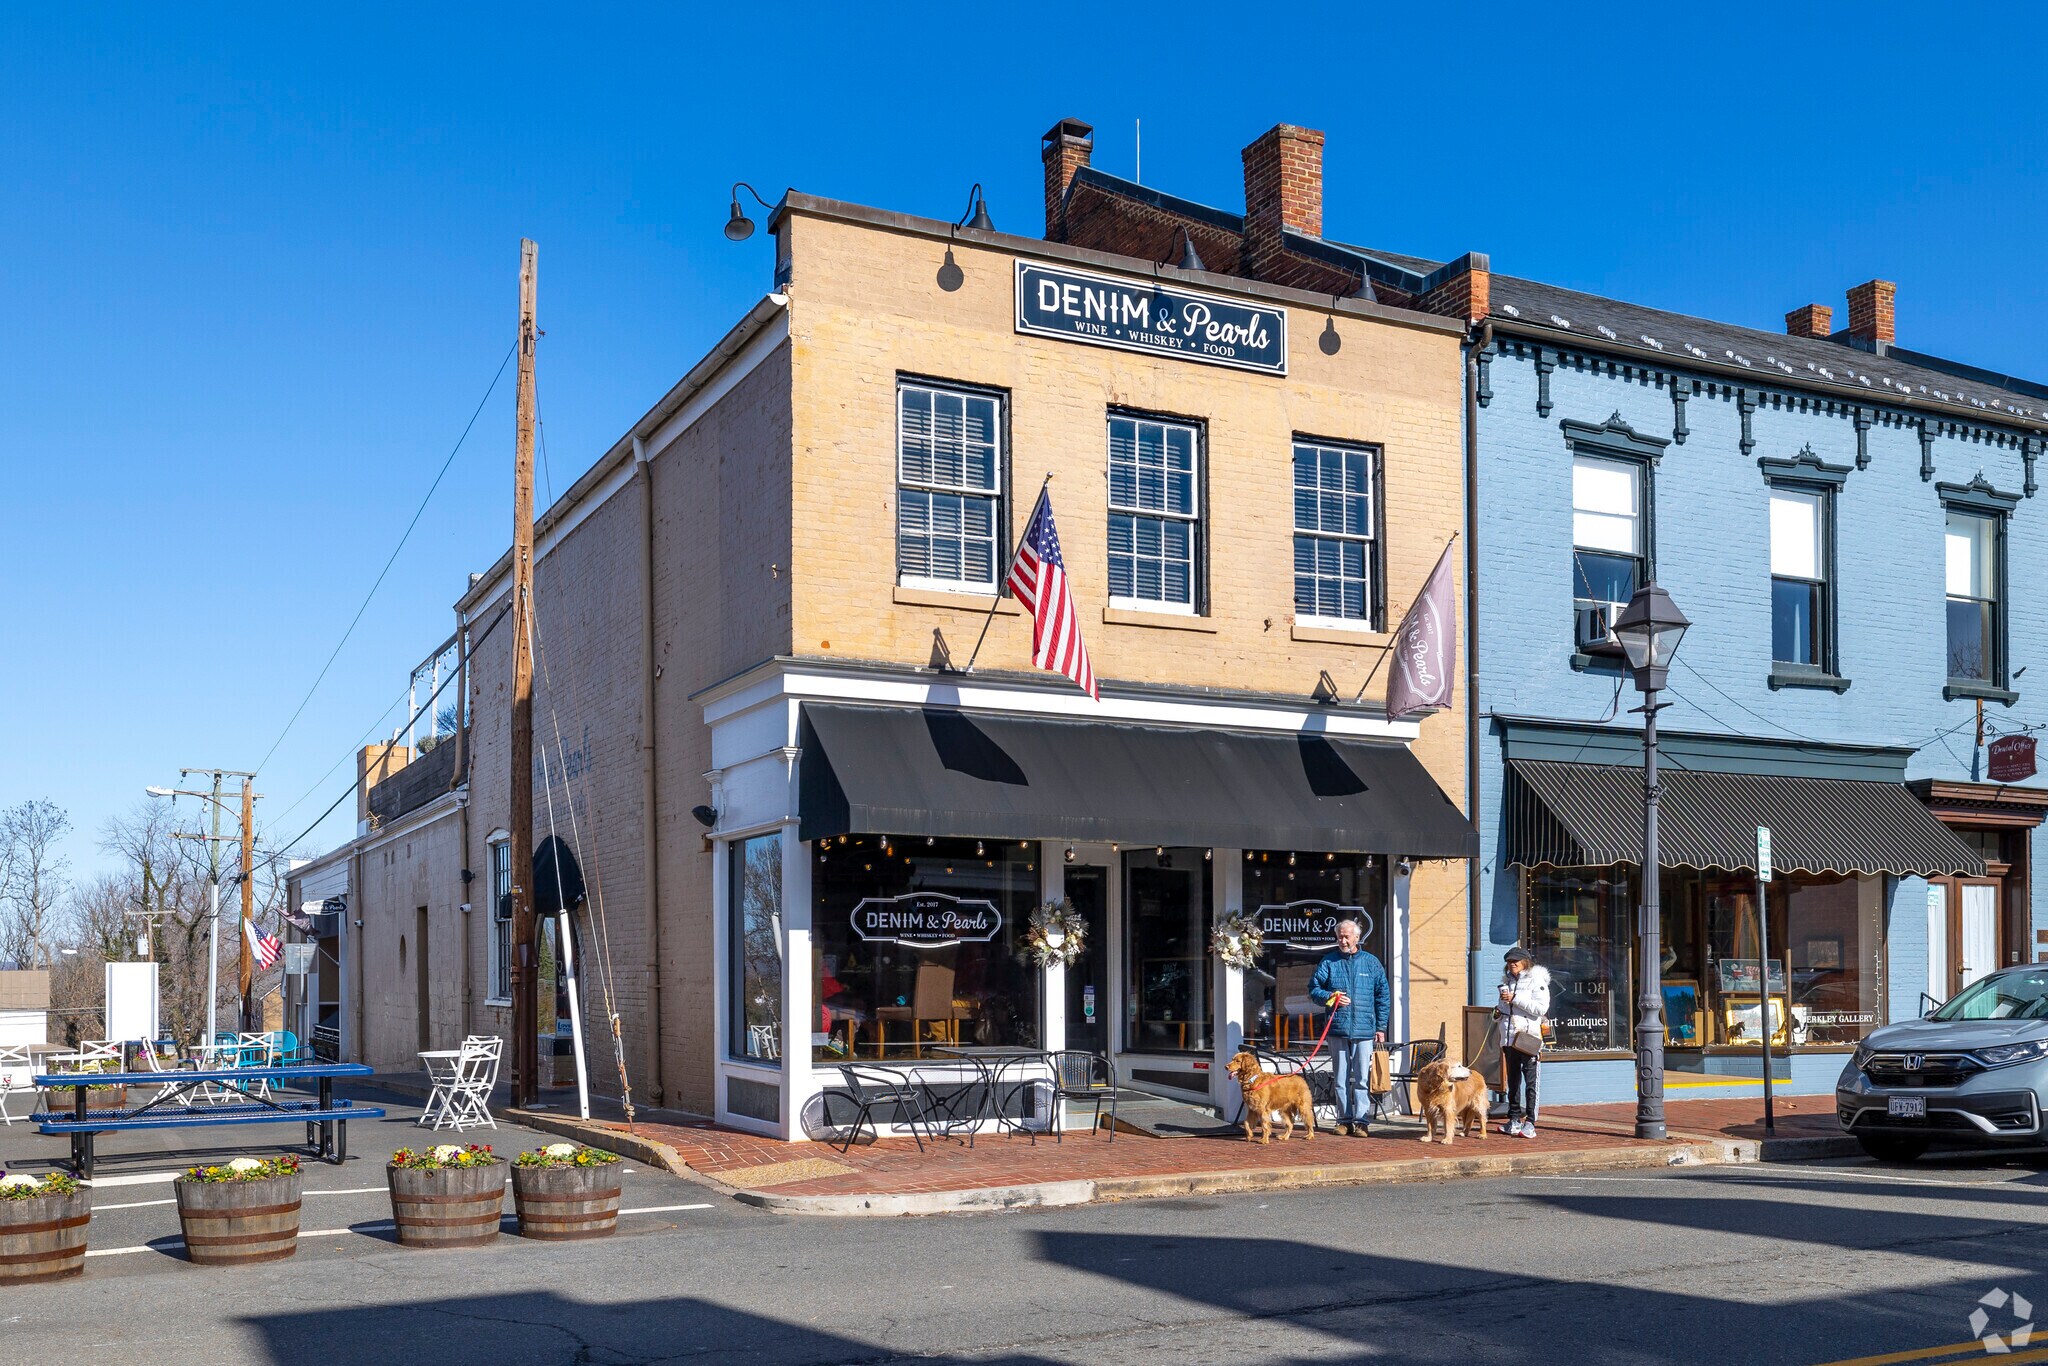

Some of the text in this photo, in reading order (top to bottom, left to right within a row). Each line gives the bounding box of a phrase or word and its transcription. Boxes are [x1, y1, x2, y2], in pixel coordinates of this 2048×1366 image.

[1038, 278, 1271, 349] DENIM & Pearls
[1074, 320, 1236, 358] WINE WHISKEY FOOD
[1411, 639, 1436, 687] Pearls
[866, 911, 988, 930] DENIM & Pearls
[1263, 918, 1310, 932] DENIM
[1312, 920, 1323, 933] &
[1544, 1014, 1608, 1029] art antiques
[1804, 1014, 1874, 1023] ERKLEY GALLERY
